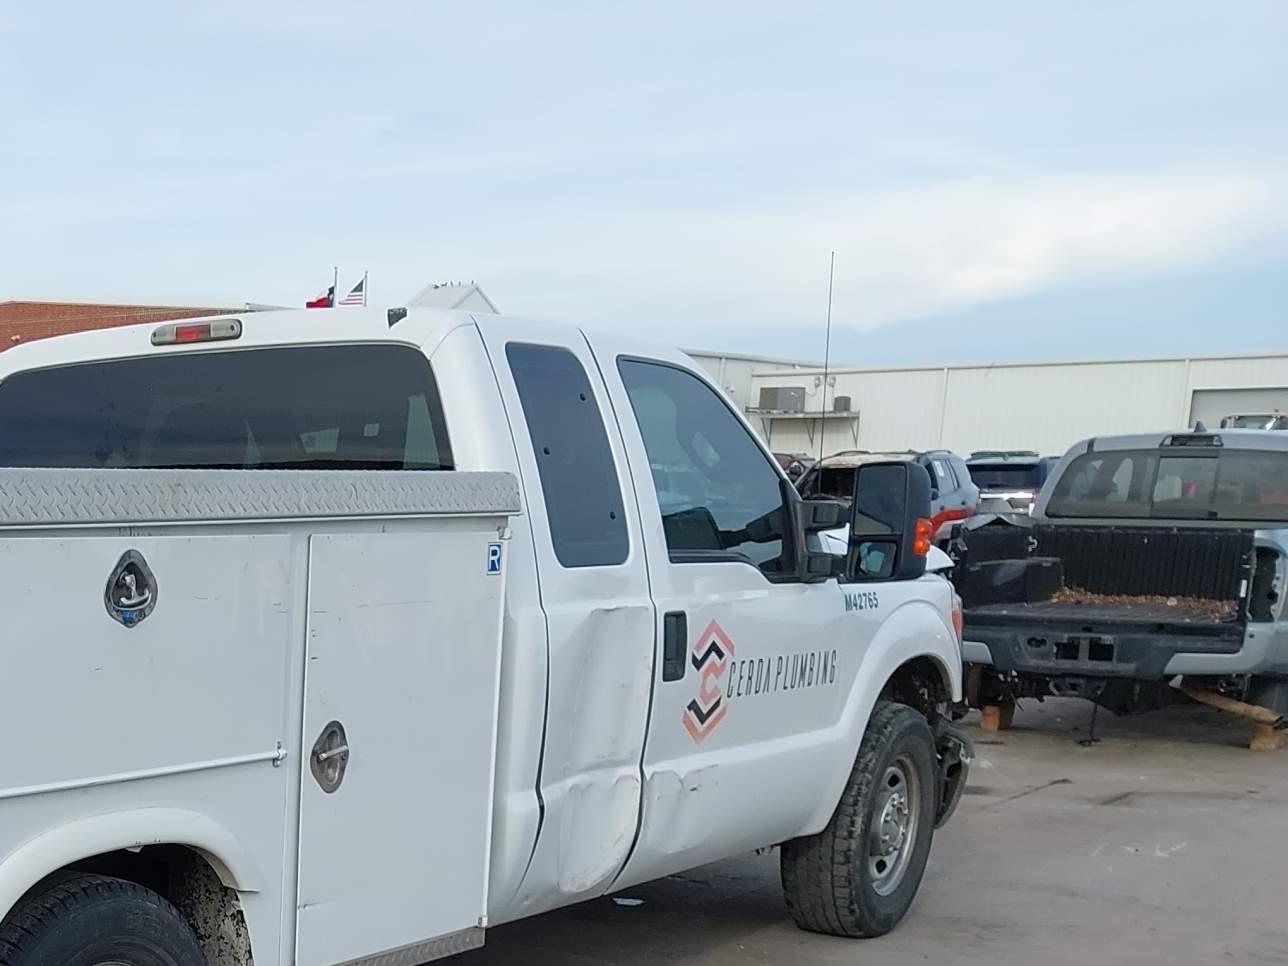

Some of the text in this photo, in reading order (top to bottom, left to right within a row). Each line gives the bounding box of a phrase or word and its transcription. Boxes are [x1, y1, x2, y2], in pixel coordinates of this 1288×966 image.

[488, 545, 500, 570] R
[844, 591, 879, 611] M42765
[727, 649, 837, 698] CERDA PLUMBING
